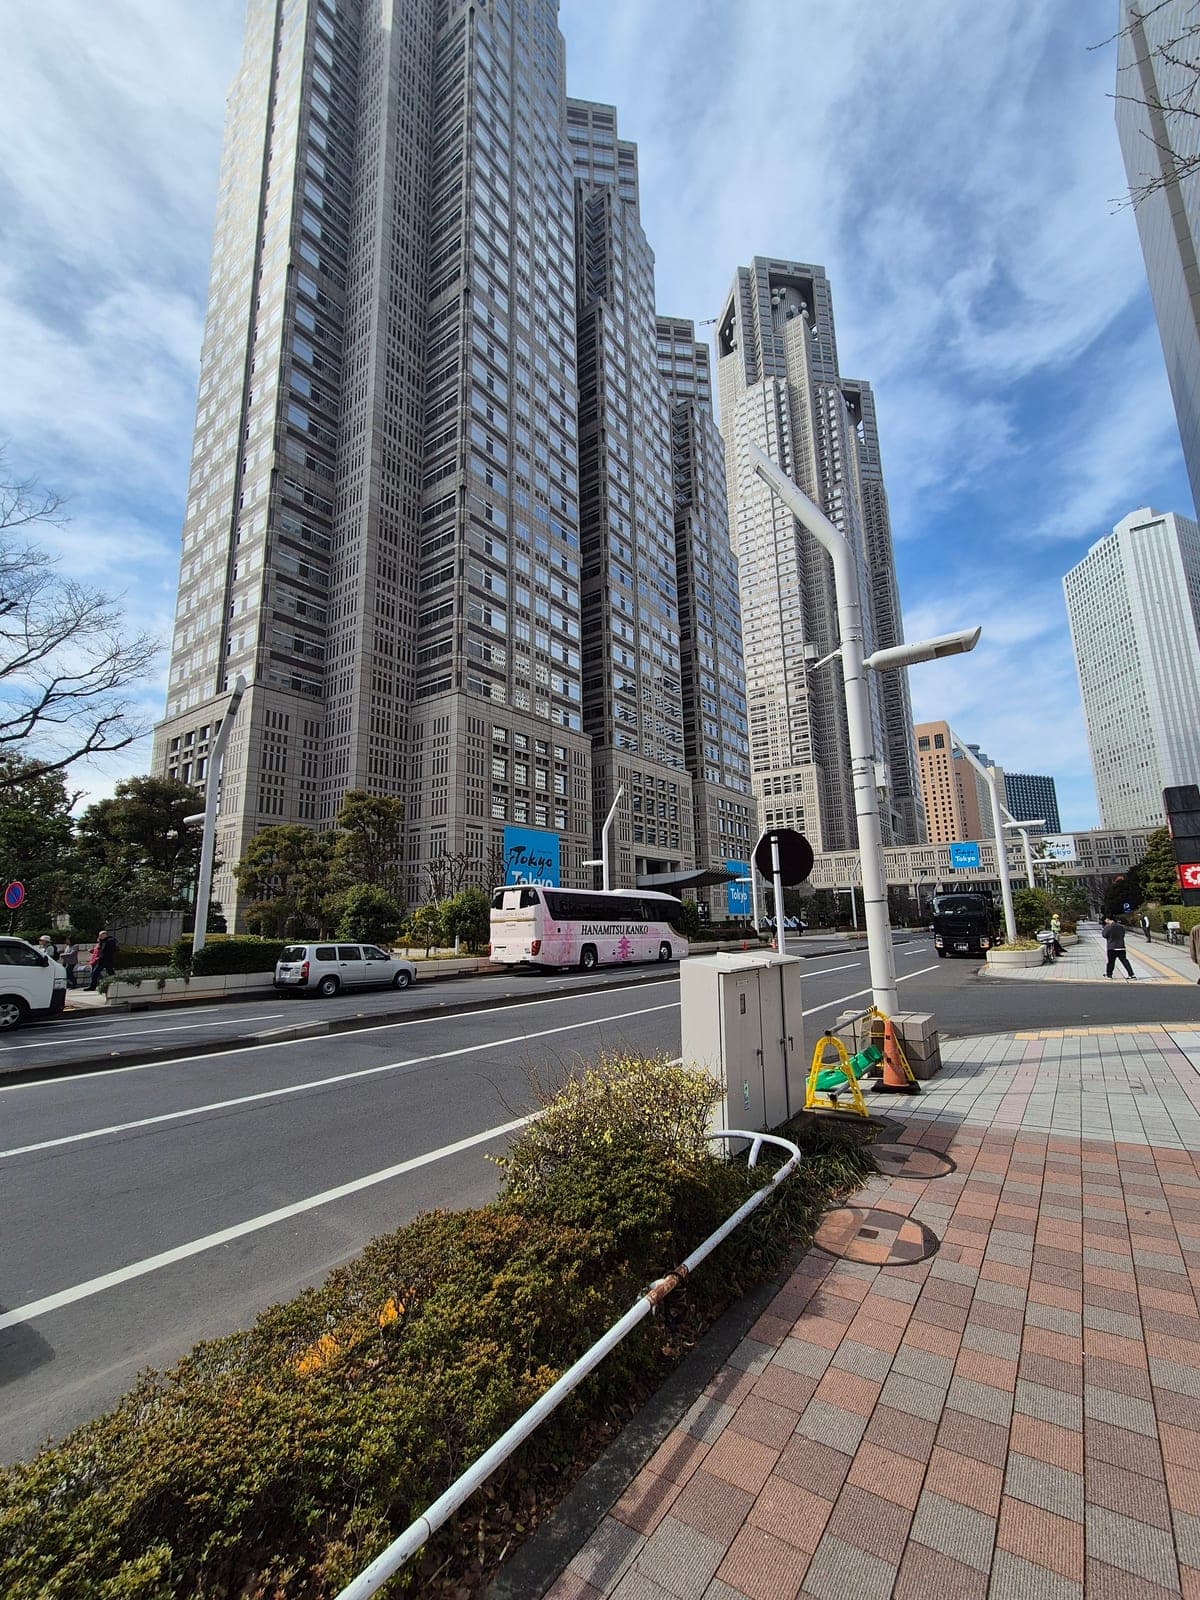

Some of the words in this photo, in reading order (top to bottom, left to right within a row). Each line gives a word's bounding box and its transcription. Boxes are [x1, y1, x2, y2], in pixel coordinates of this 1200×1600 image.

[509, 846, 552, 877] Tokyo
[955, 855, 976, 863] Tokyo
[730, 888, 748, 904] Tokyo
[581, 924, 625, 936] HANAMITSU
[625, 924, 649, 935] KANKO
